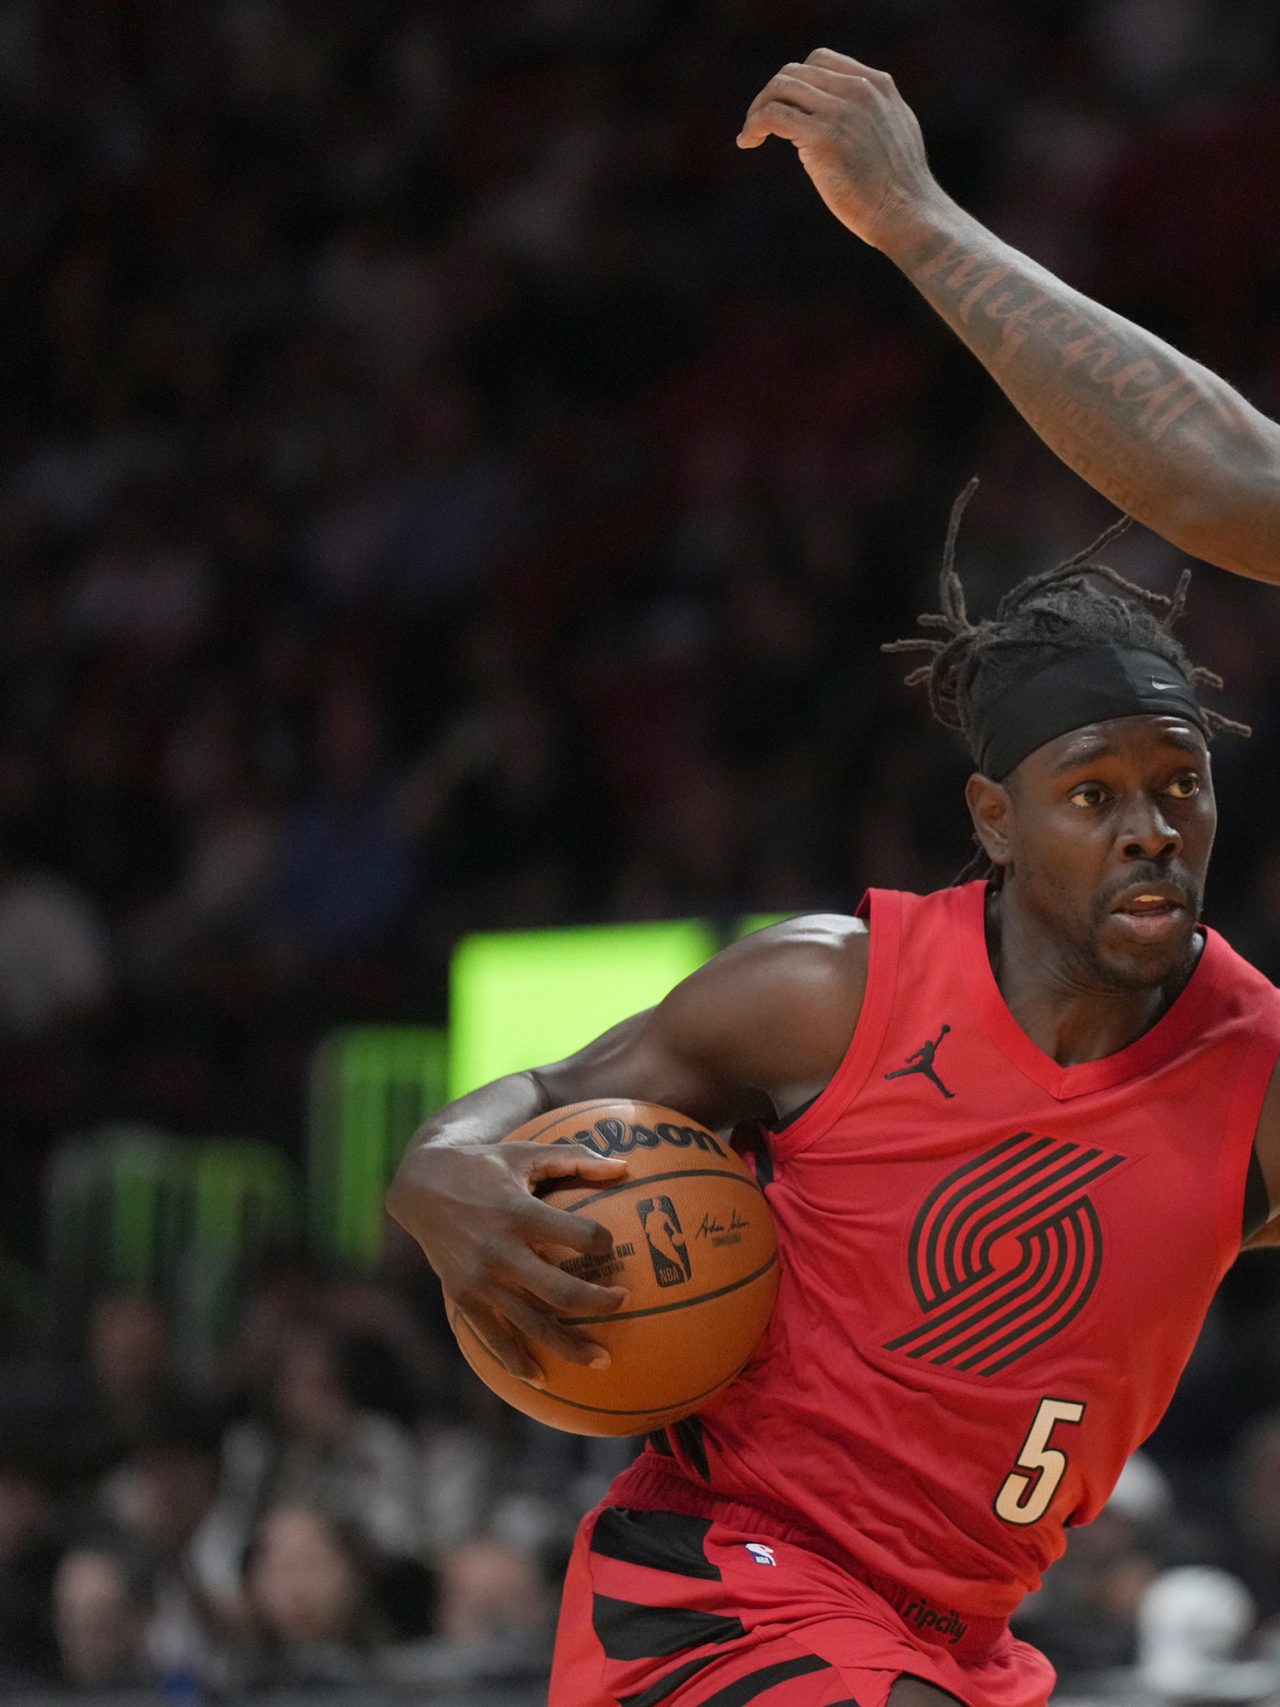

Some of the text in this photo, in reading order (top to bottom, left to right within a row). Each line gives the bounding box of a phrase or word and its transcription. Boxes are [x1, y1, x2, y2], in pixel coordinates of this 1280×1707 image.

[551, 1117, 729, 1160] ilson
[659, 1264, 681, 1285] NBA
[992, 1395, 1087, 1526] 5
